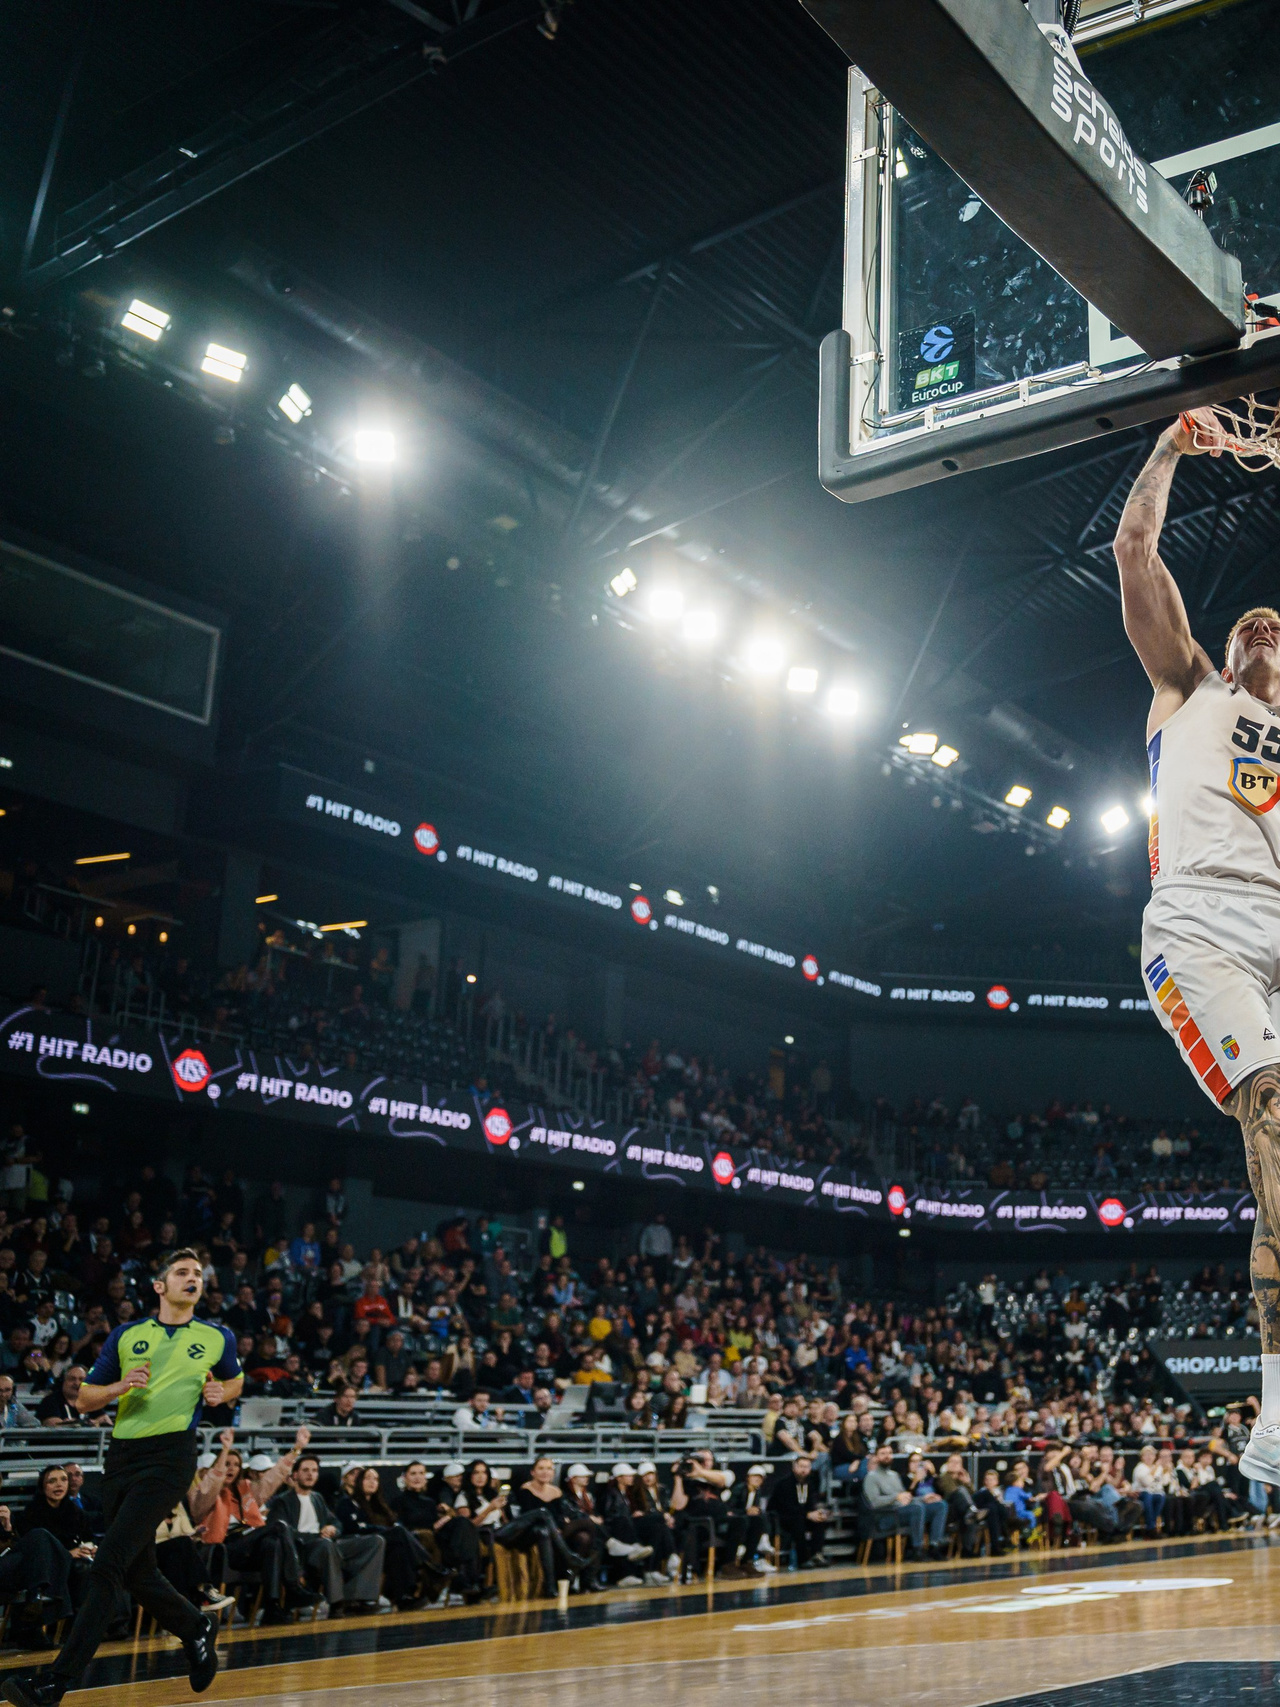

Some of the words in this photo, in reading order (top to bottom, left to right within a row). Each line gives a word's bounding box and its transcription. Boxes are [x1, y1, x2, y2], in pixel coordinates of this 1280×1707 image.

[915, 362, 959, 388] BKT
[912, 381, 964, 403] EuroCup
[1240, 772, 1274, 790] BT
[306, 794, 324, 811] #1
[325, 800, 352, 820] HIT
[353, 809, 402, 837] RADIO
[456, 845, 472, 861] #1
[473, 850, 497, 868] HIT
[496, 857, 539, 882] RADIO
[563, 879, 585, 897] HIT
[584, 887, 623, 910] RADIO
[931, 989, 976, 1003] RADIO
[1043, 995, 1067, 1007] HIT
[1066, 996, 1109, 1010] RADIO
[8, 1030, 35, 1053] #1
[38, 1035, 79, 1060] HIT
[81, 1042, 153, 1073] RADIO
[236, 1072, 259, 1092] #1
[260, 1076, 294, 1098] HIT
[294, 1082, 353, 1109] RADIO
[368, 1096, 388, 1115] #1
[389, 1100, 419, 1120] HIT
[419, 1105, 471, 1130] RADIO
[529, 1127, 547, 1144] #1
[547, 1129, 573, 1148] HIT
[572, 1134, 616, 1156] RADIO
[641, 1147, 665, 1165] HIT
[664, 1151, 704, 1172] RADIO
[996, 1205, 1014, 1218] #1
[1014, 1205, 1040, 1219] HIT
[1040, 1205, 1087, 1220] RADIO
[1142, 1206, 1159, 1220] #1
[1159, 1207, 1184, 1220] HIT
[1183, 1206, 1229, 1220] RADIO
